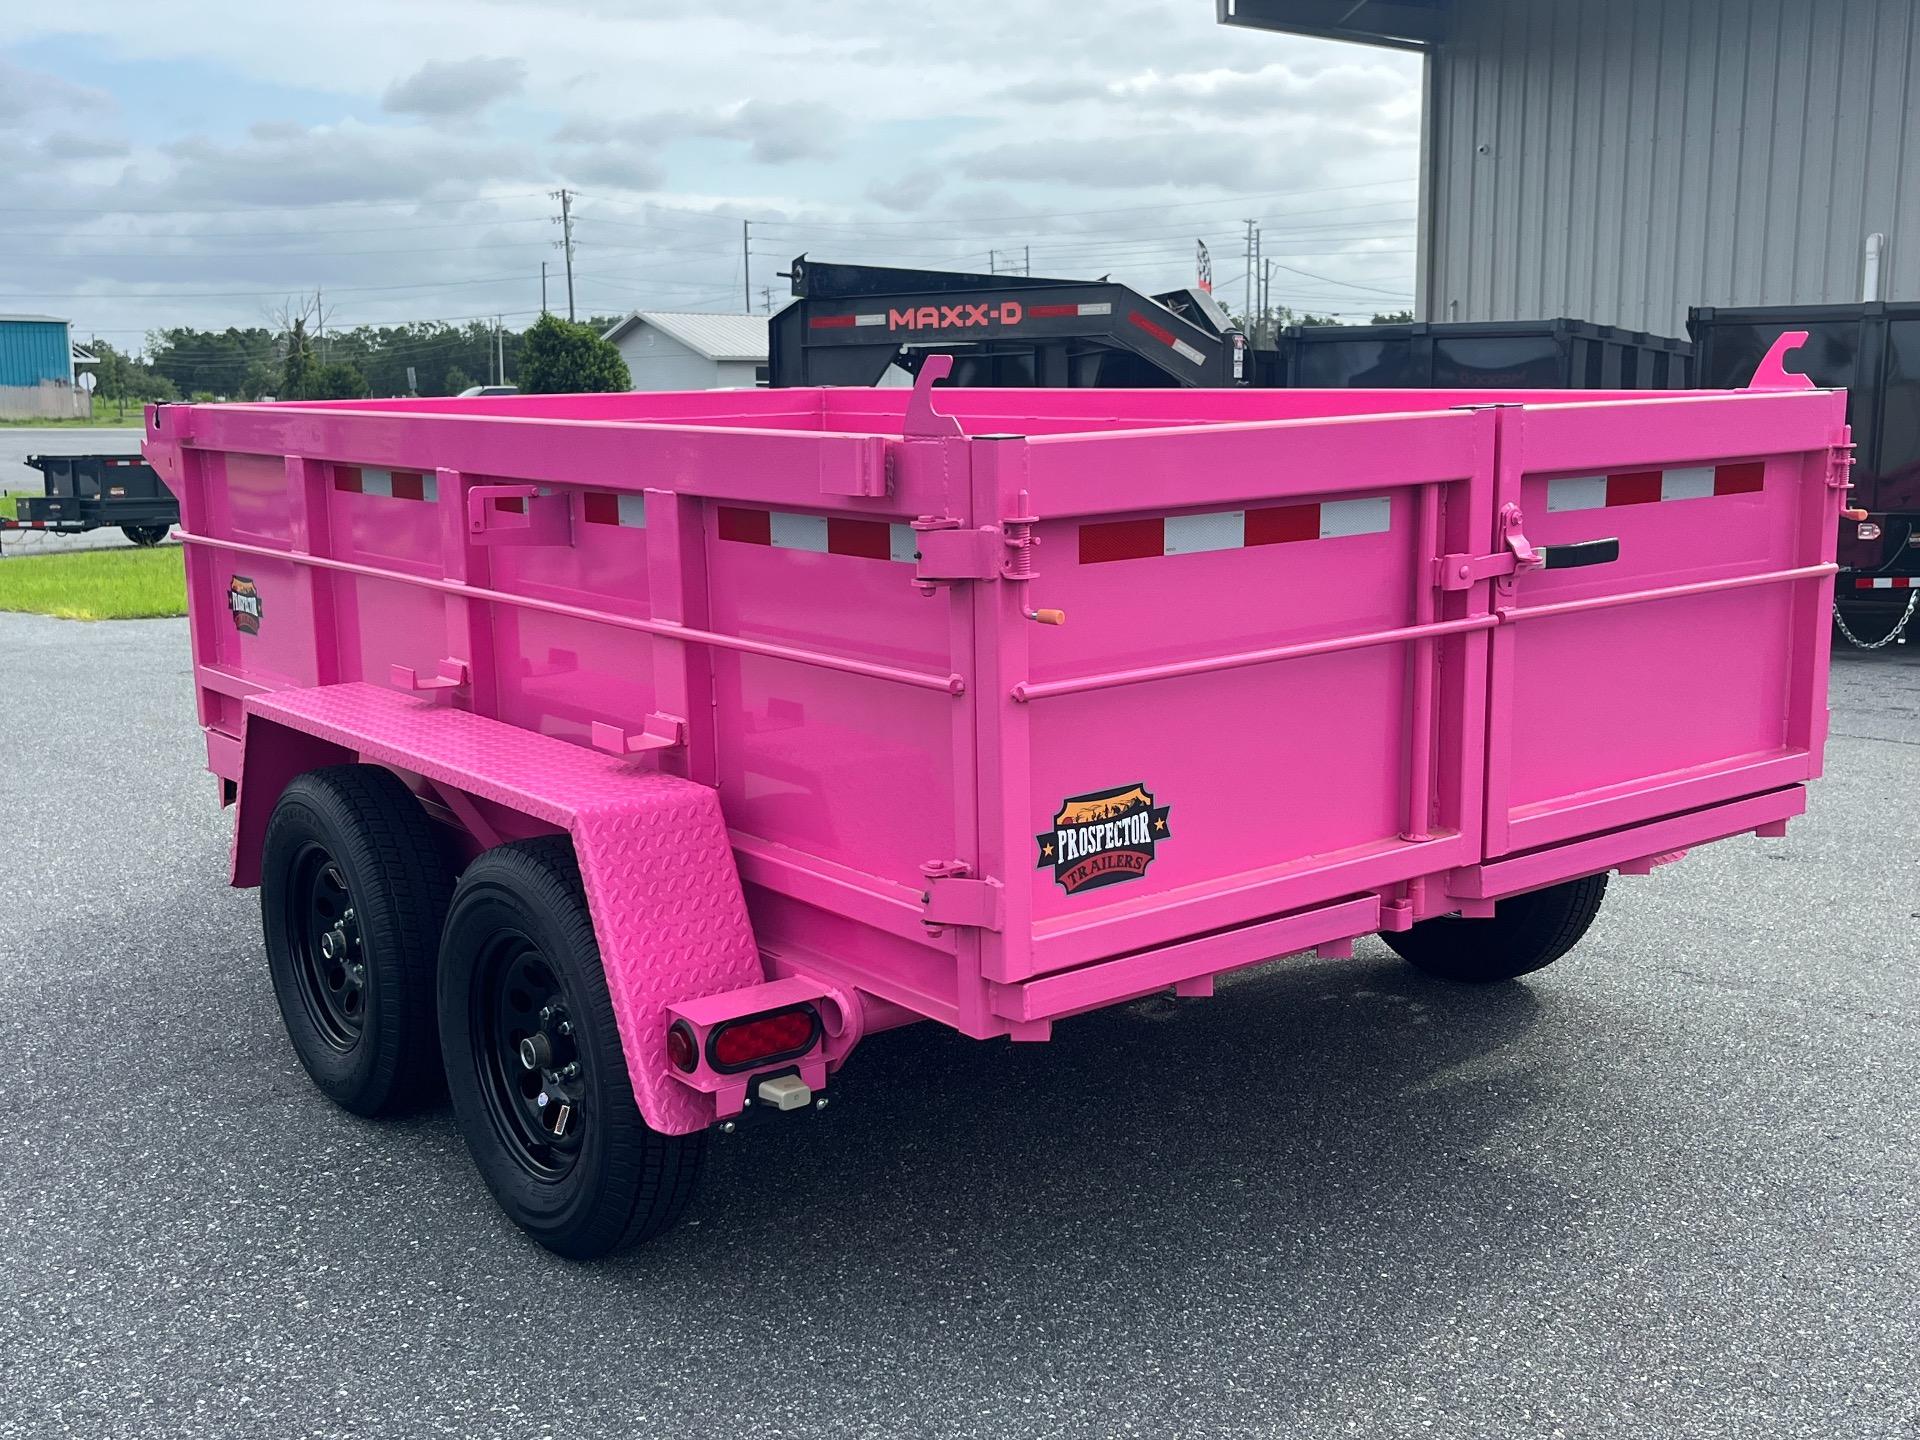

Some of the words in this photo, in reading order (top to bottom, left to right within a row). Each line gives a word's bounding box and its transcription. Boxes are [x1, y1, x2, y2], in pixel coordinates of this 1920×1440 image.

[889, 302, 1022, 331] MAXX-D
[1057, 811, 1151, 864] PROSPECTOR
[1067, 855, 1143, 886] TRAILERS
